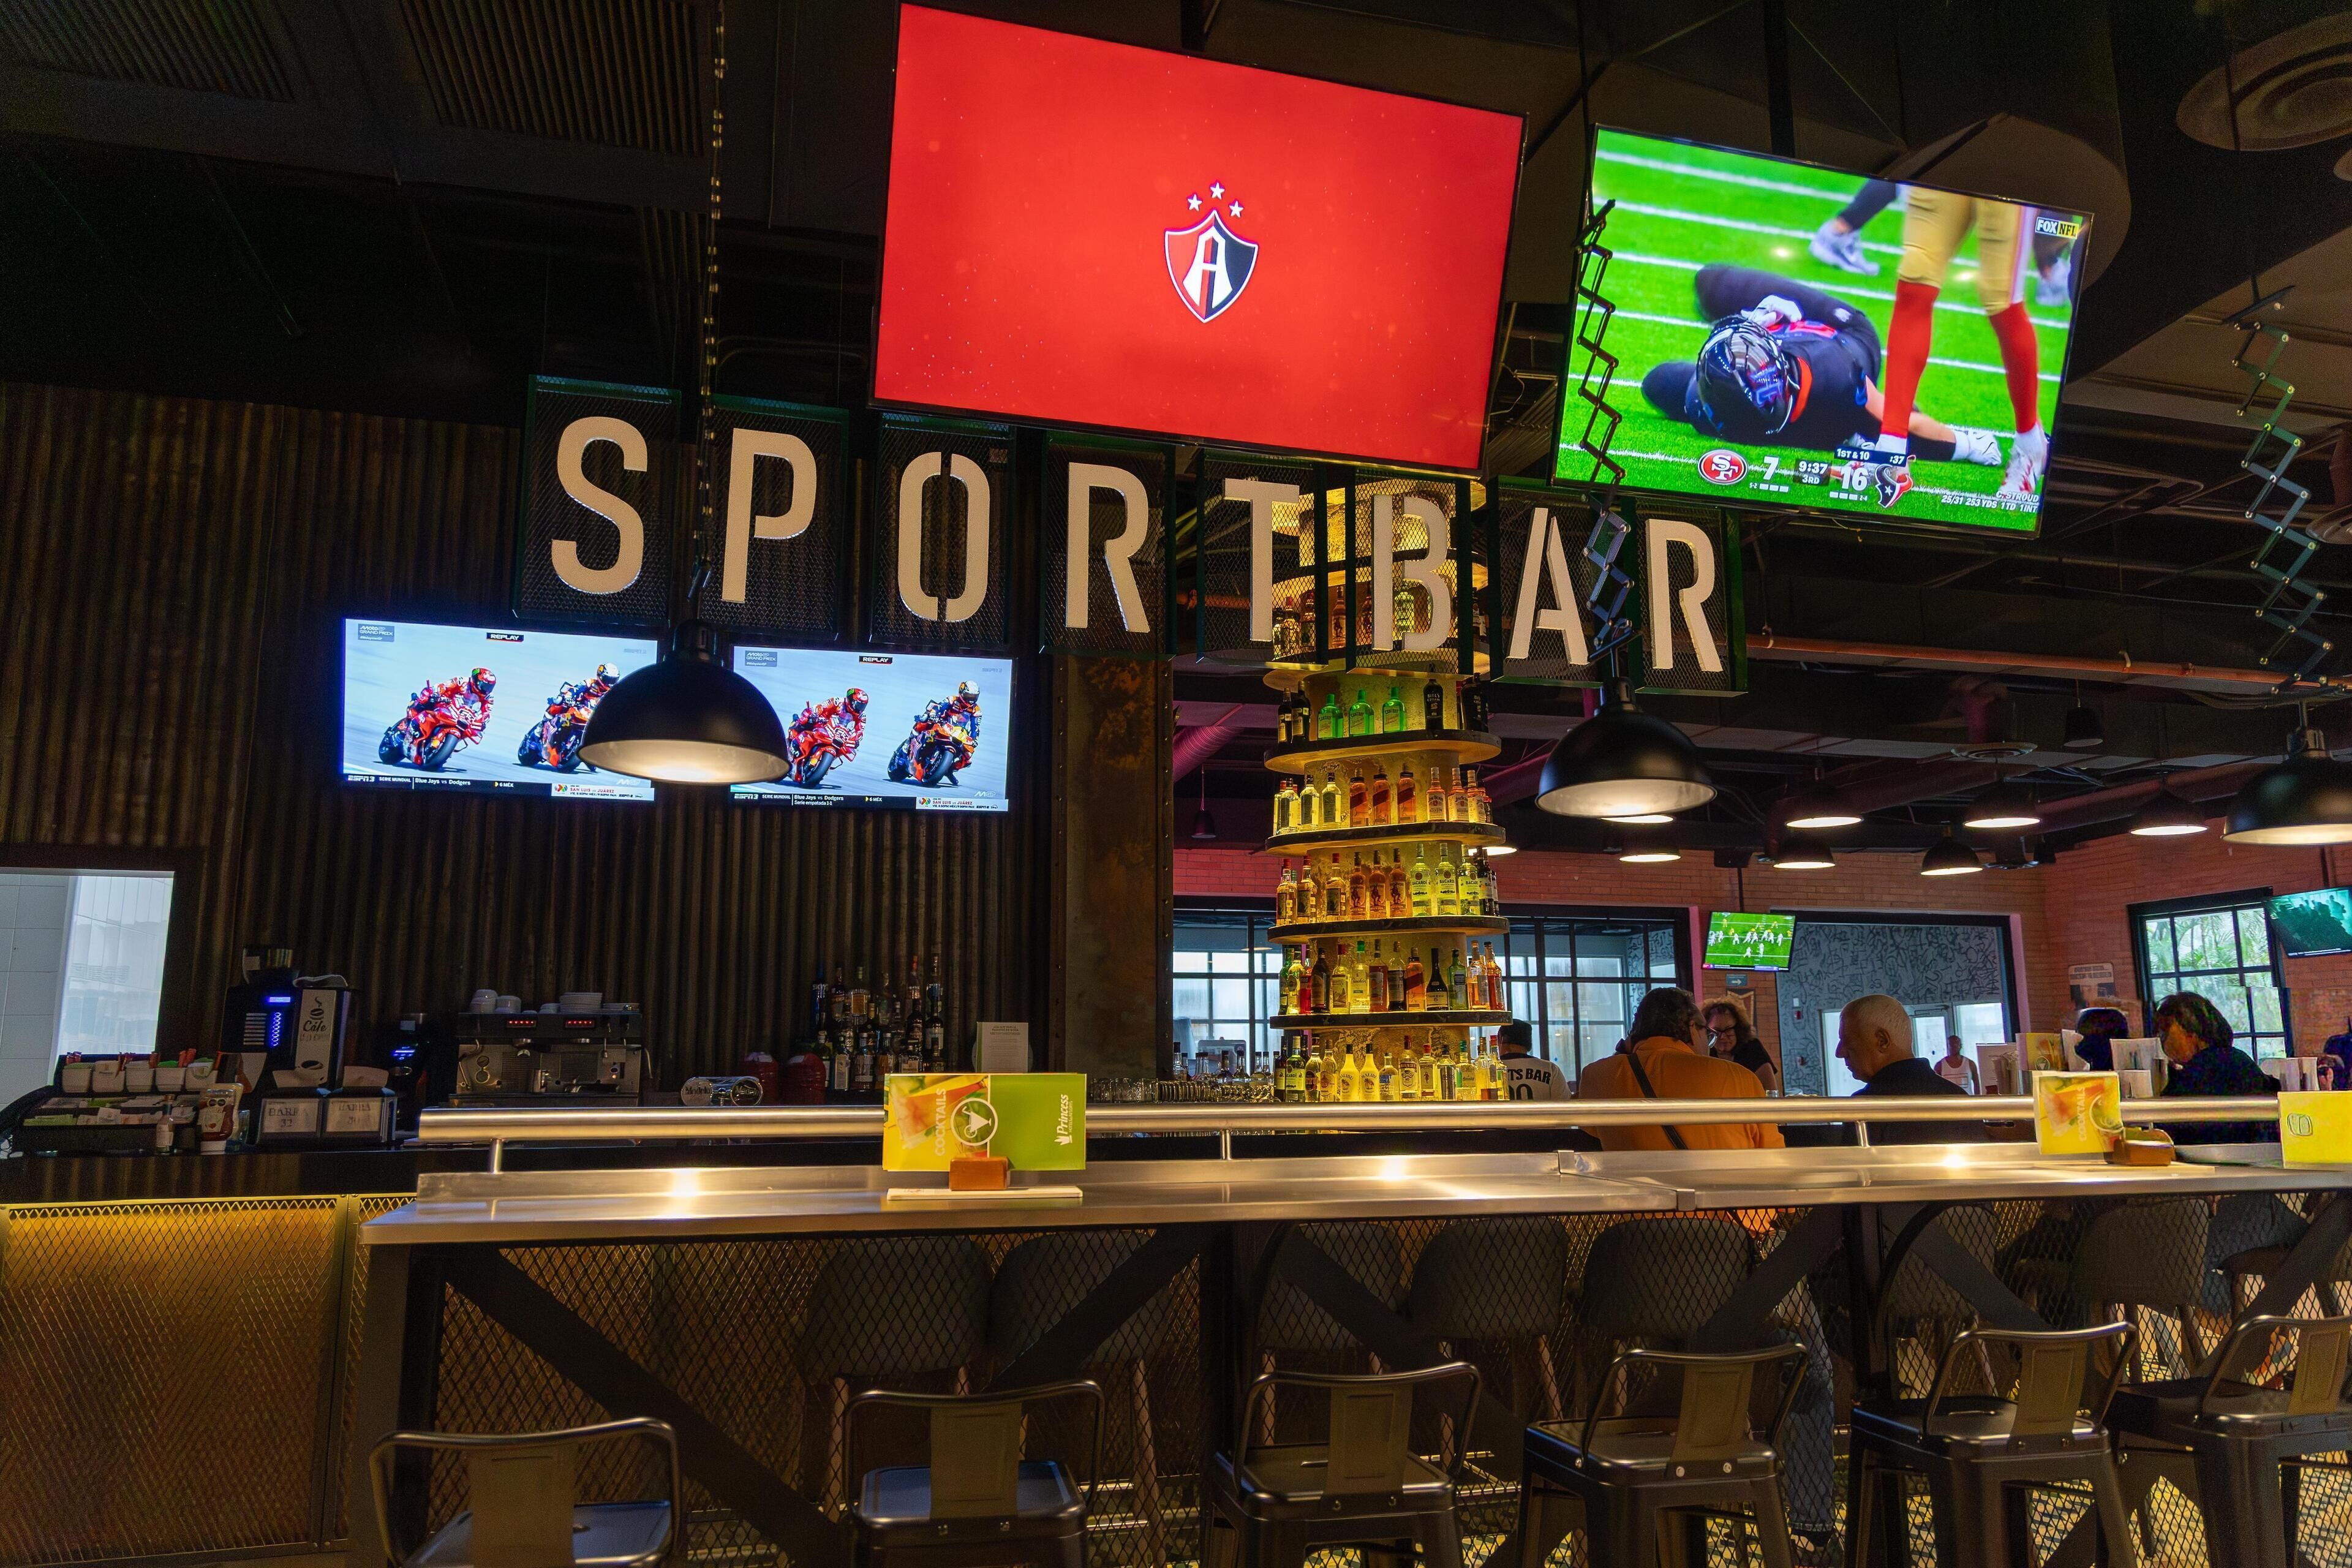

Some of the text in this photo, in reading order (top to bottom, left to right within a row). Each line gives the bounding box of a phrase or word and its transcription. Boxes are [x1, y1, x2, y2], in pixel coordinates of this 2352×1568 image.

[2037, 219, 2076, 237] FOX NFL
[1837, 448, 1852, 458] 1ST
[1852, 451, 1858, 459] &
[1860, 451, 1870, 460] 10
[1763, 456, 1780, 481] 7
[1799, 461, 1828, 475] 9:37
[1802, 474, 1820, 484] 3RD
[1841, 466, 1868, 491] 16
[1941, 495, 2038, 513] 25/31 253 YDS 1TD 1INT
[2006, 491, 2039, 502] STROUD
[1526, 1068, 1551, 1084] BAR
[935, 1088, 946, 1156] COCKTAILS
[1057, 1093, 1069, 1135] Princess
[2077, 1087, 2087, 1142] COCKTAILS
